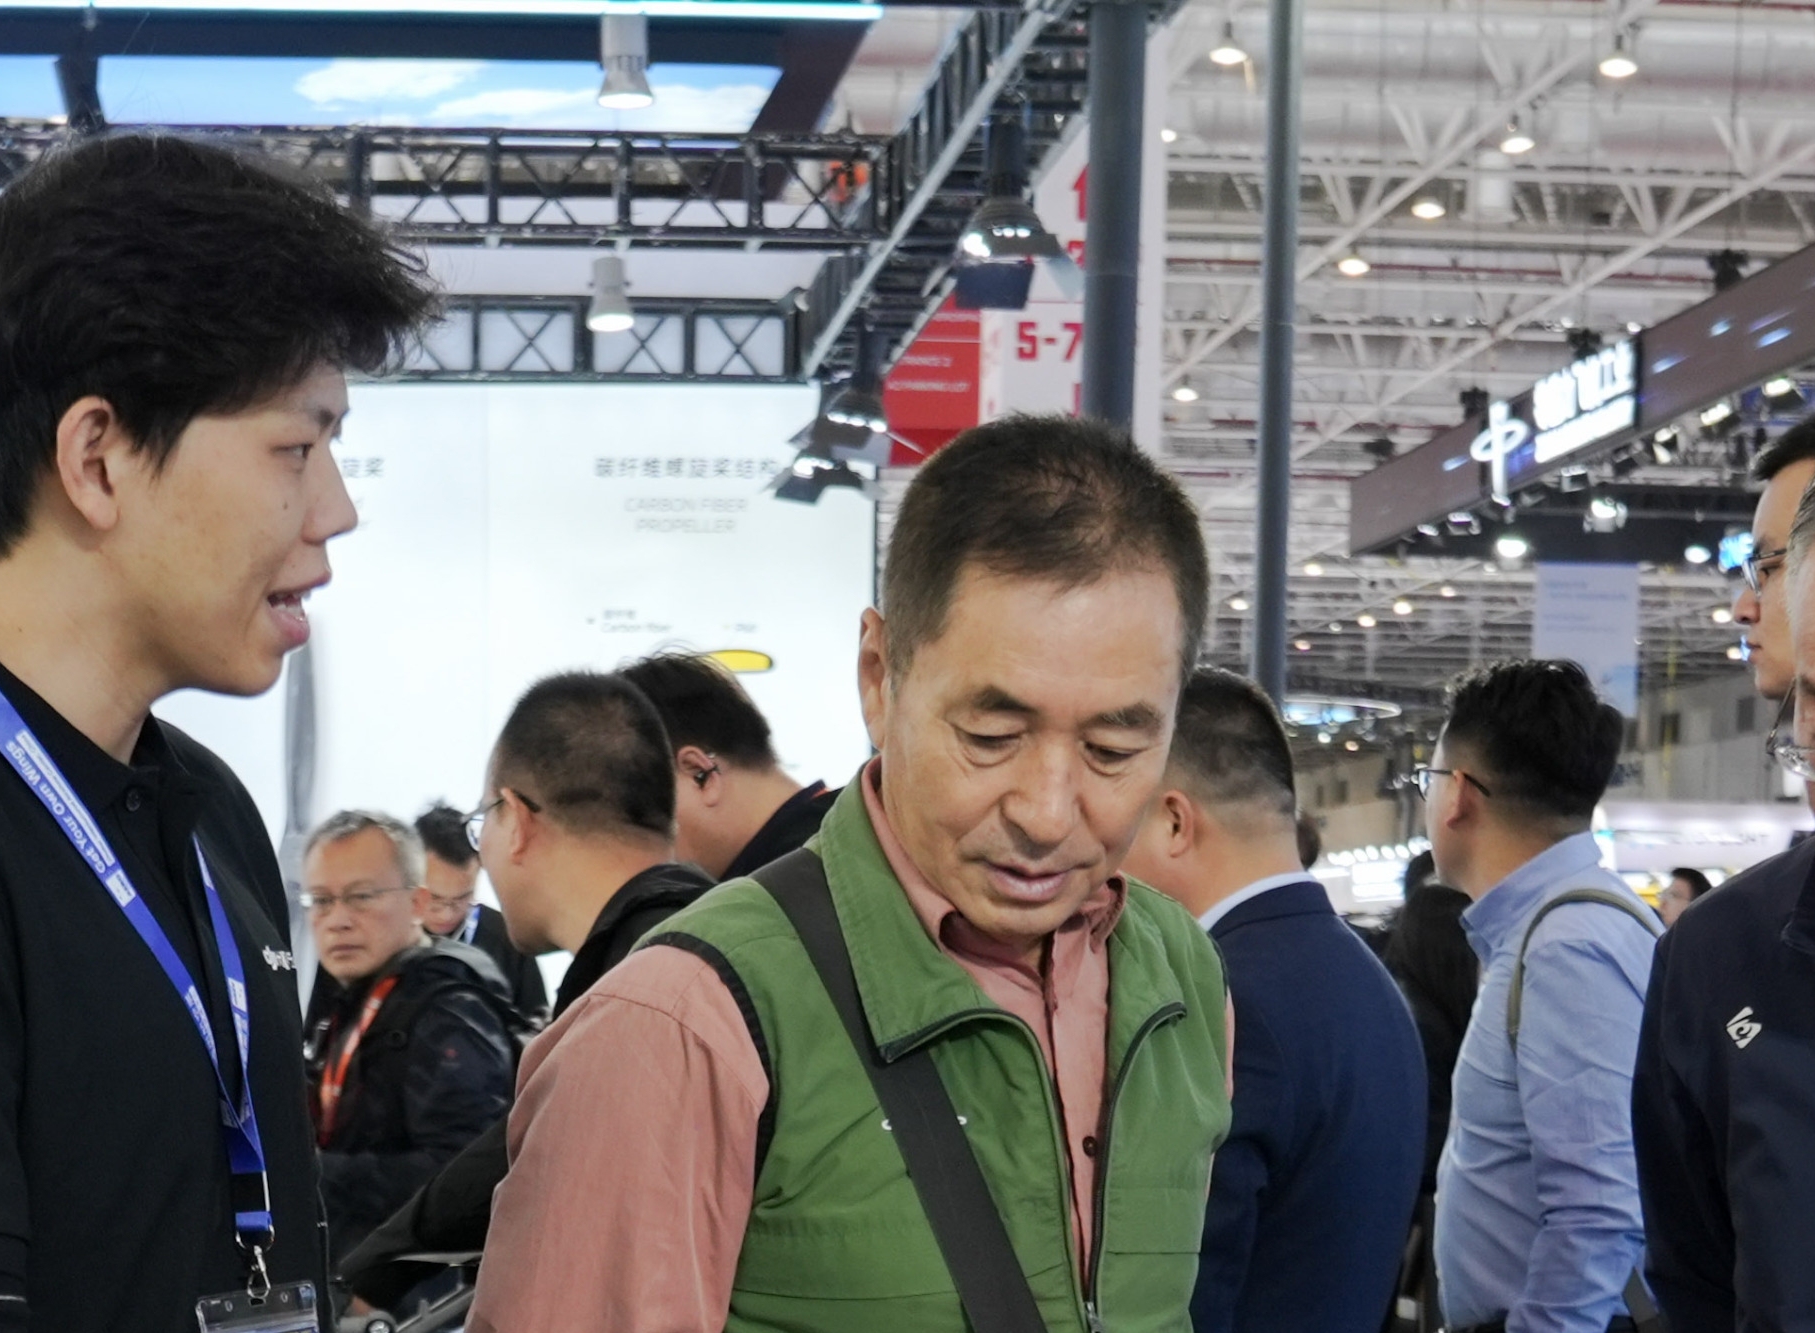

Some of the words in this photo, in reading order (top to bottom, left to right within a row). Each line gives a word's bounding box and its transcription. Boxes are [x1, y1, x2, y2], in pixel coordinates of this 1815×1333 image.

[5, 739, 42, 787] Wings
[40, 781, 66, 816] Own
[63, 814, 89, 850] Your
